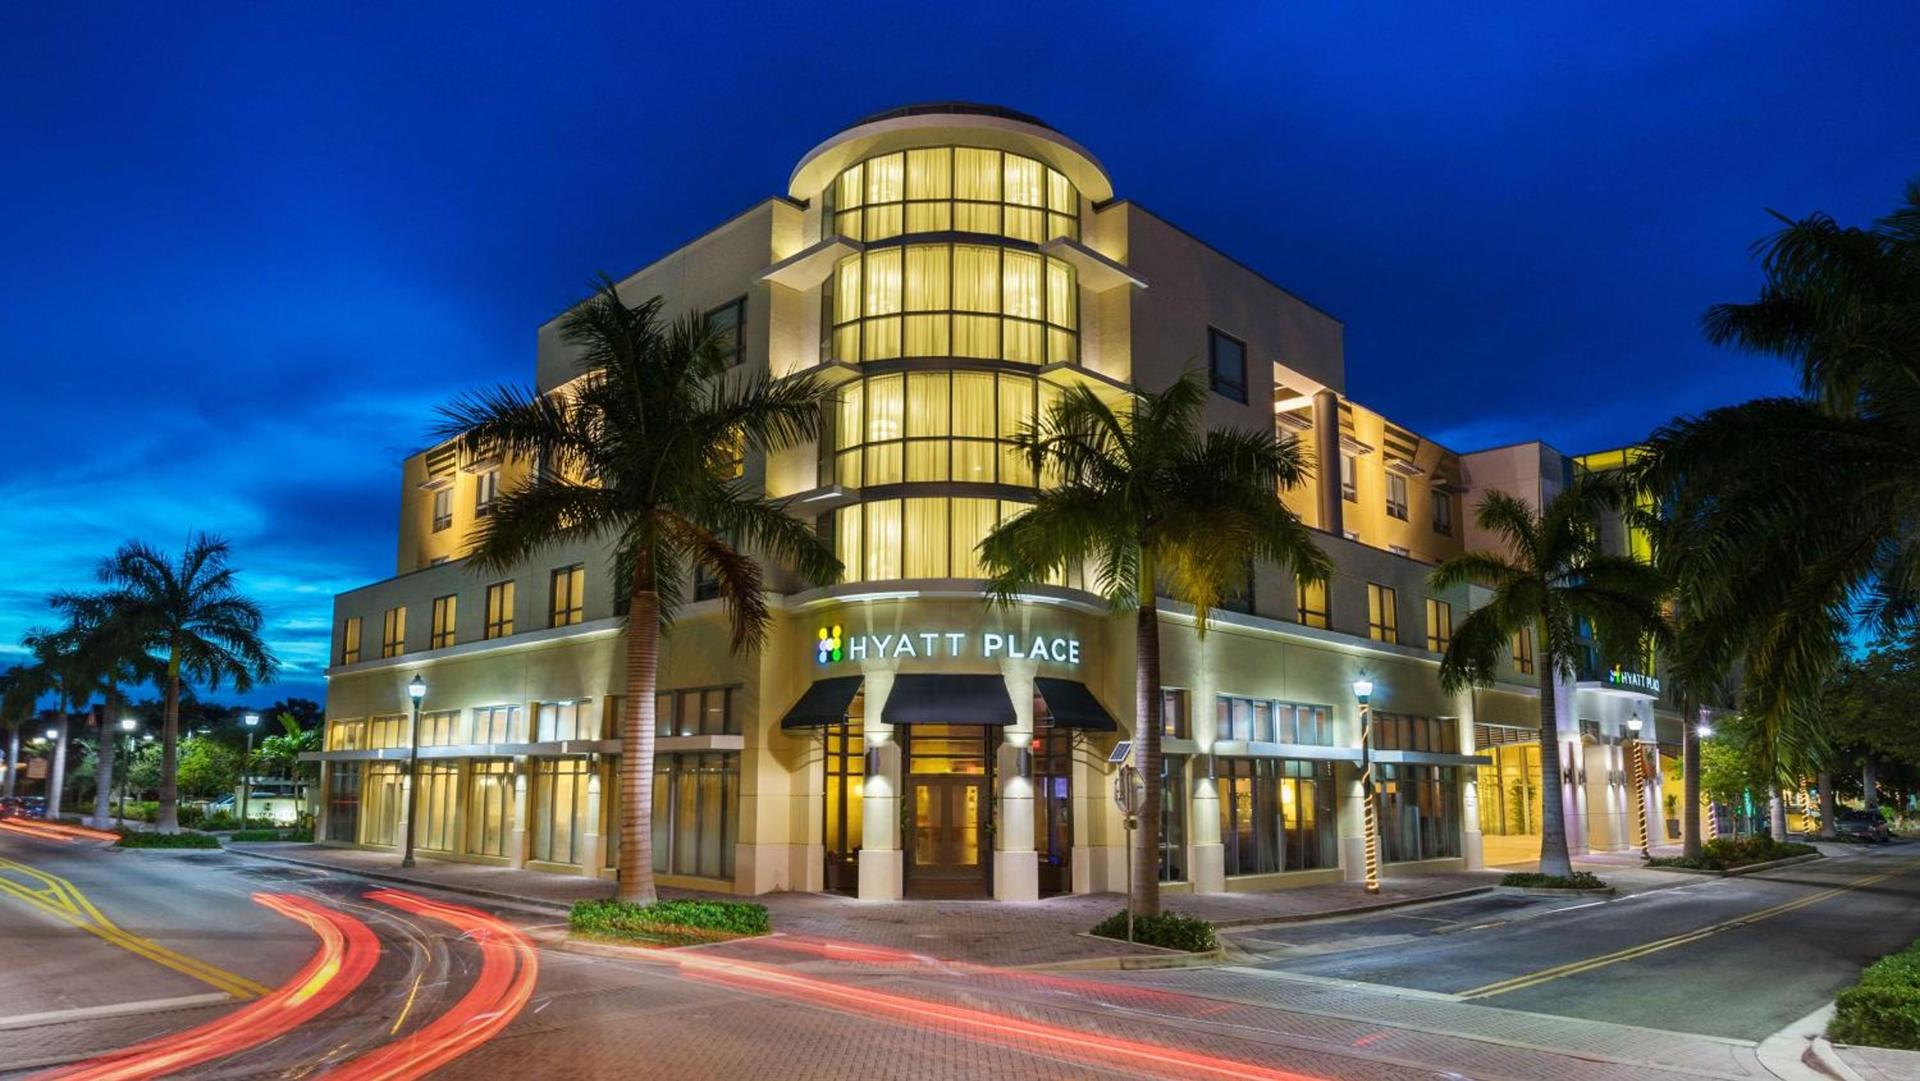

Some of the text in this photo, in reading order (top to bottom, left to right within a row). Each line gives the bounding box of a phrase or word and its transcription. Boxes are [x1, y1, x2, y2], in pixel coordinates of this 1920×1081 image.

[850, 633, 1080, 664] HYATT PLACE
[1621, 671, 1645, 687] HYATT
